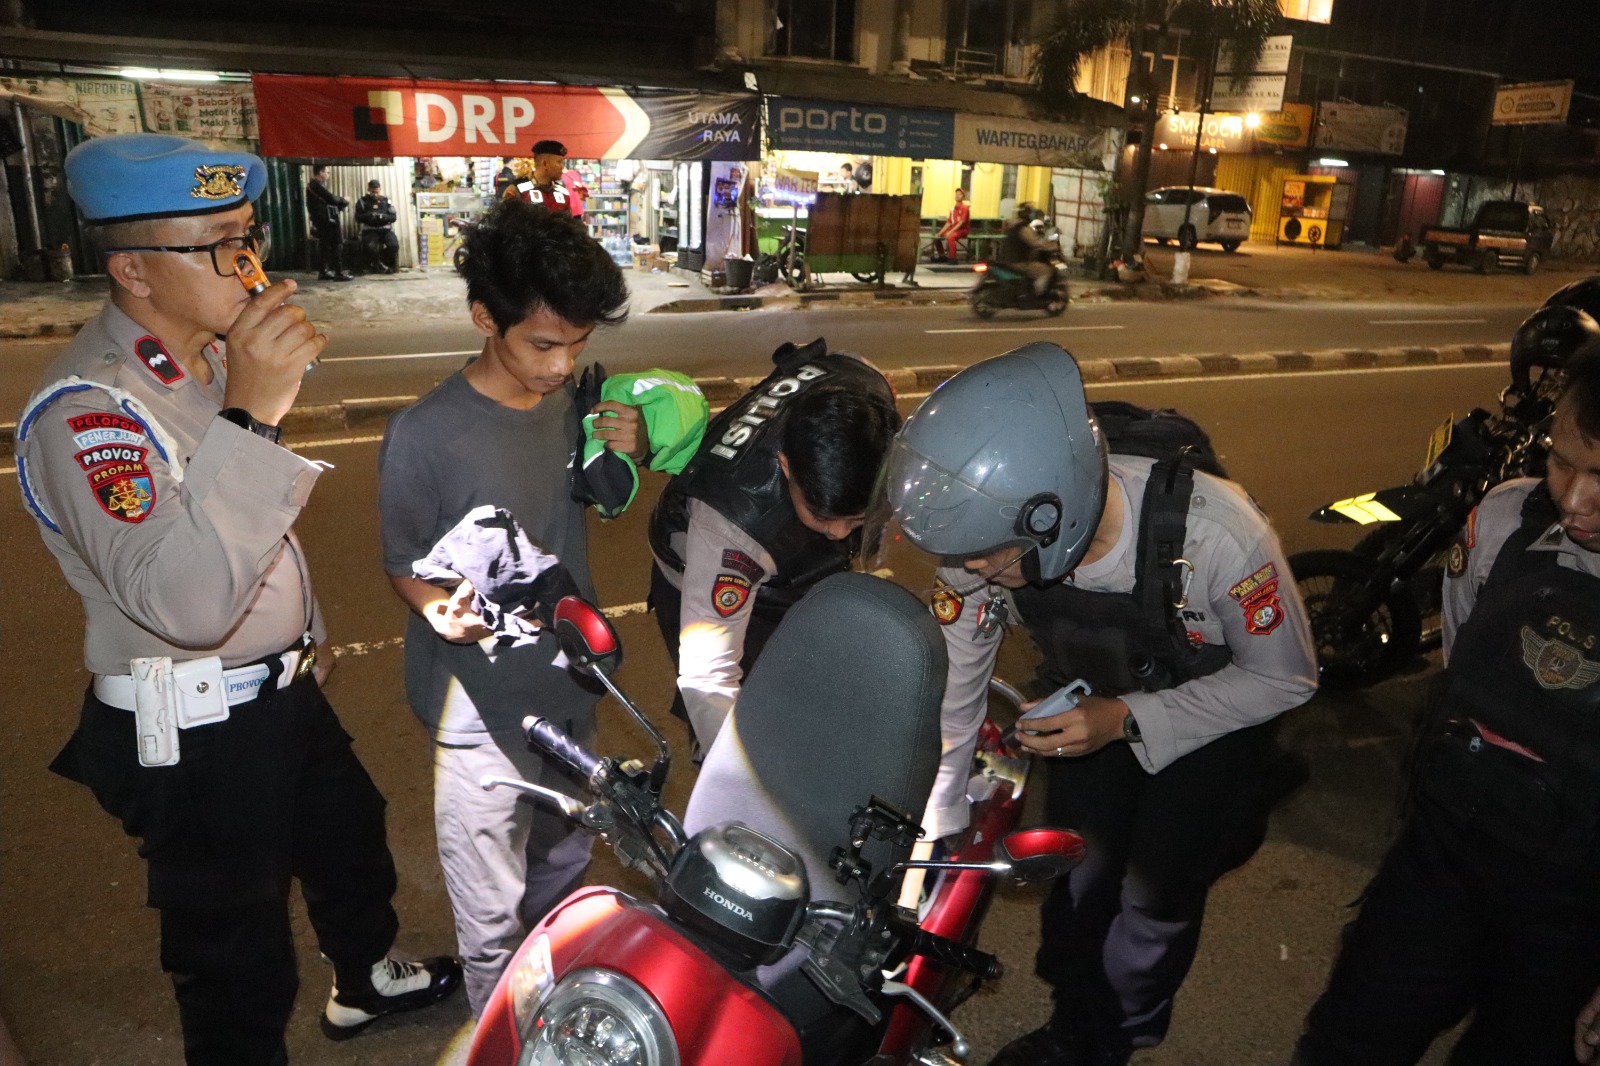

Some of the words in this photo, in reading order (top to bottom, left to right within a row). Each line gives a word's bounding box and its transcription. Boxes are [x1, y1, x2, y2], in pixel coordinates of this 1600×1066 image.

[76, 82, 117, 95] NIPPON
[198, 97, 229, 107] Bebas
[199, 108, 229, 117] Motor
[415, 93, 536, 144] DRP
[688, 111, 742, 125] UTAMA
[779, 106, 887, 133] porto
[200, 117, 230, 127] Makin
[1169, 115, 1243, 140] SMOOCH
[703, 130, 741, 143] RAYA
[976, 128, 1036, 149] WARTEG
[1180, 135, 1197, 145] THE
[1200, 136, 1227, 149] LABEL
[710, 364, 828, 461] POLISI
[83, 447, 142, 466] PROVOS
[93, 463, 143, 482] PROPAM
[1181, 610, 1206, 622] RI
[229, 676, 266, 693] PROVOS
[702, 886, 754, 922] HONDA
